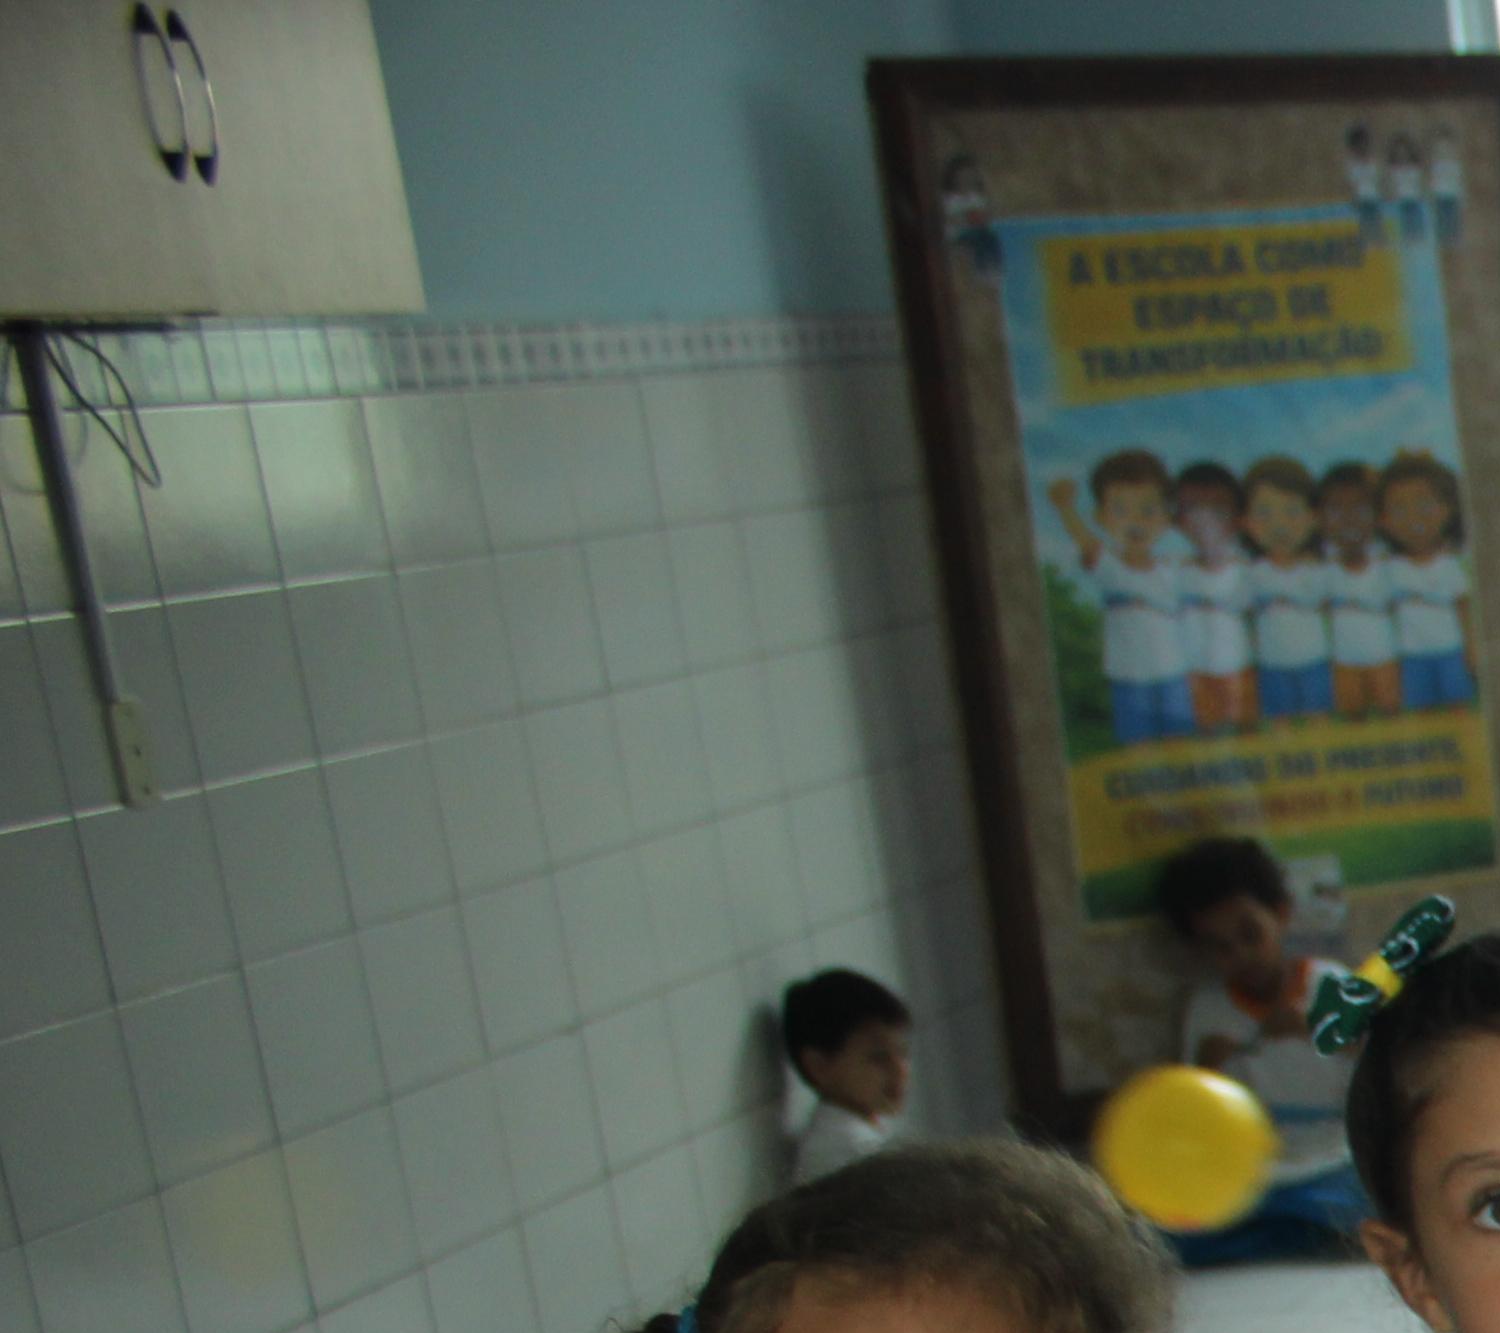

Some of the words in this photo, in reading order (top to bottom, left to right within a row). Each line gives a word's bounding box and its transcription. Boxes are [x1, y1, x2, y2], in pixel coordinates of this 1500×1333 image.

[1068, 250, 1094, 286] A
[1103, 241, 1246, 285] ESCOLA
[1132, 286, 1280, 333] ESPAÇO
[1287, 284, 1330, 317] DE
